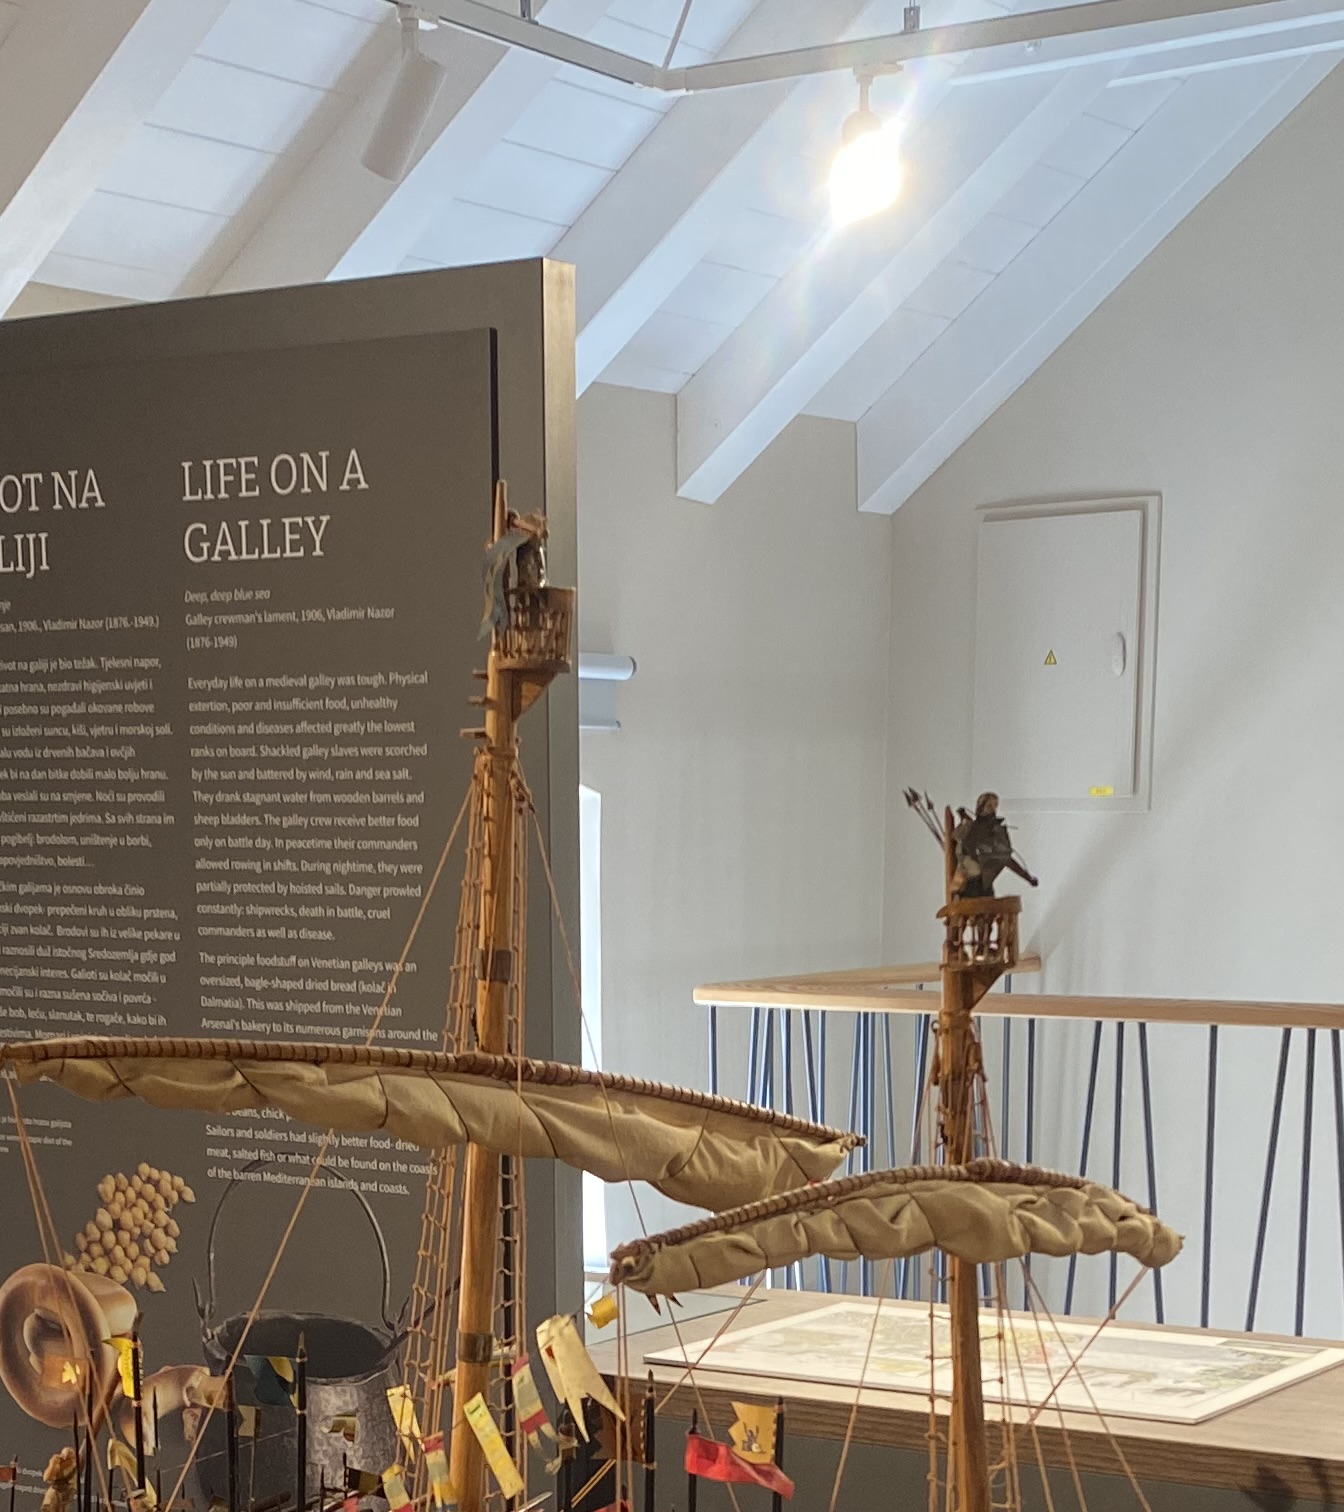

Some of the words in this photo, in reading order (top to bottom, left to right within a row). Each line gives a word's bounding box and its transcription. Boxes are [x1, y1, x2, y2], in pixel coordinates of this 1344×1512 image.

[181, 456, 259, 502] LIFE
[270, 451, 331, 496] ON
[340, 448, 369, 492] A
[52, 468, 105, 510] NA
[183, 515, 331, 564] GALLEY
[233, 587, 253, 601] blue
[185, 612, 213, 627] Galley
[326, 606, 365, 620] Vladimir
[366, 606, 394, 619] Nazor
[187, 676, 228, 691] Everyday
[229, 675, 243, 688] life
[244, 678, 257, 688] on
[258, 678, 264, 687] a
[265, 674, 307, 687] medieval
[308, 673, 335, 689] galley
[336, 676, 355, 686] was
[388, 671, 428, 686] Physical
[231, 701, 253, 713] poor
[254, 698, 272, 710] and
[350, 696, 398, 710] unhealthy
[189, 723, 236, 735] conditions
[237, 722, 255, 734] and
[255, 722, 294, 734] diseases
[295, 720, 332, 733] affected
[333, 721, 365, 736] greatly
[366, 720, 382, 732] the
[383, 720, 415, 732] lowest
[215, 748, 228, 757] on
[259, 744, 301, 757] Shackled
[302, 744, 329, 760] galley
[330, 744, 359, 756] slaves
[360, 746, 383, 756] were
[384, 743, 427, 756] scorched
[191, 767, 203, 782] by
[203, 768, 219, 780] the
[220, 770, 236, 780] sun
[237, 767, 255, 780] and
[256, 768, 294, 779] battered
[295, 767, 307, 783] by
[335, 768, 353, 779] rain
[355, 767, 373, 780] and
[193, 790, 214, 804] They
[215, 790, 241, 802] drank
[242, 792, 281, 805] stagnant
[282, 792, 307, 803] water
[309, 790, 331, 803] from
[332, 792, 370, 803] wooden
[371, 791, 404, 803] barrels
[405, 791, 424, 803] and
[298, 905, 325, 917] death
[326, 906, 335, 917] in
[367, 906, 390, 919] cruel
[207, 1165, 217, 1178] of
[217, 1167, 232, 1179] the
[233, 1169, 262, 1182] barren
[360, 1180, 378, 1192] and
